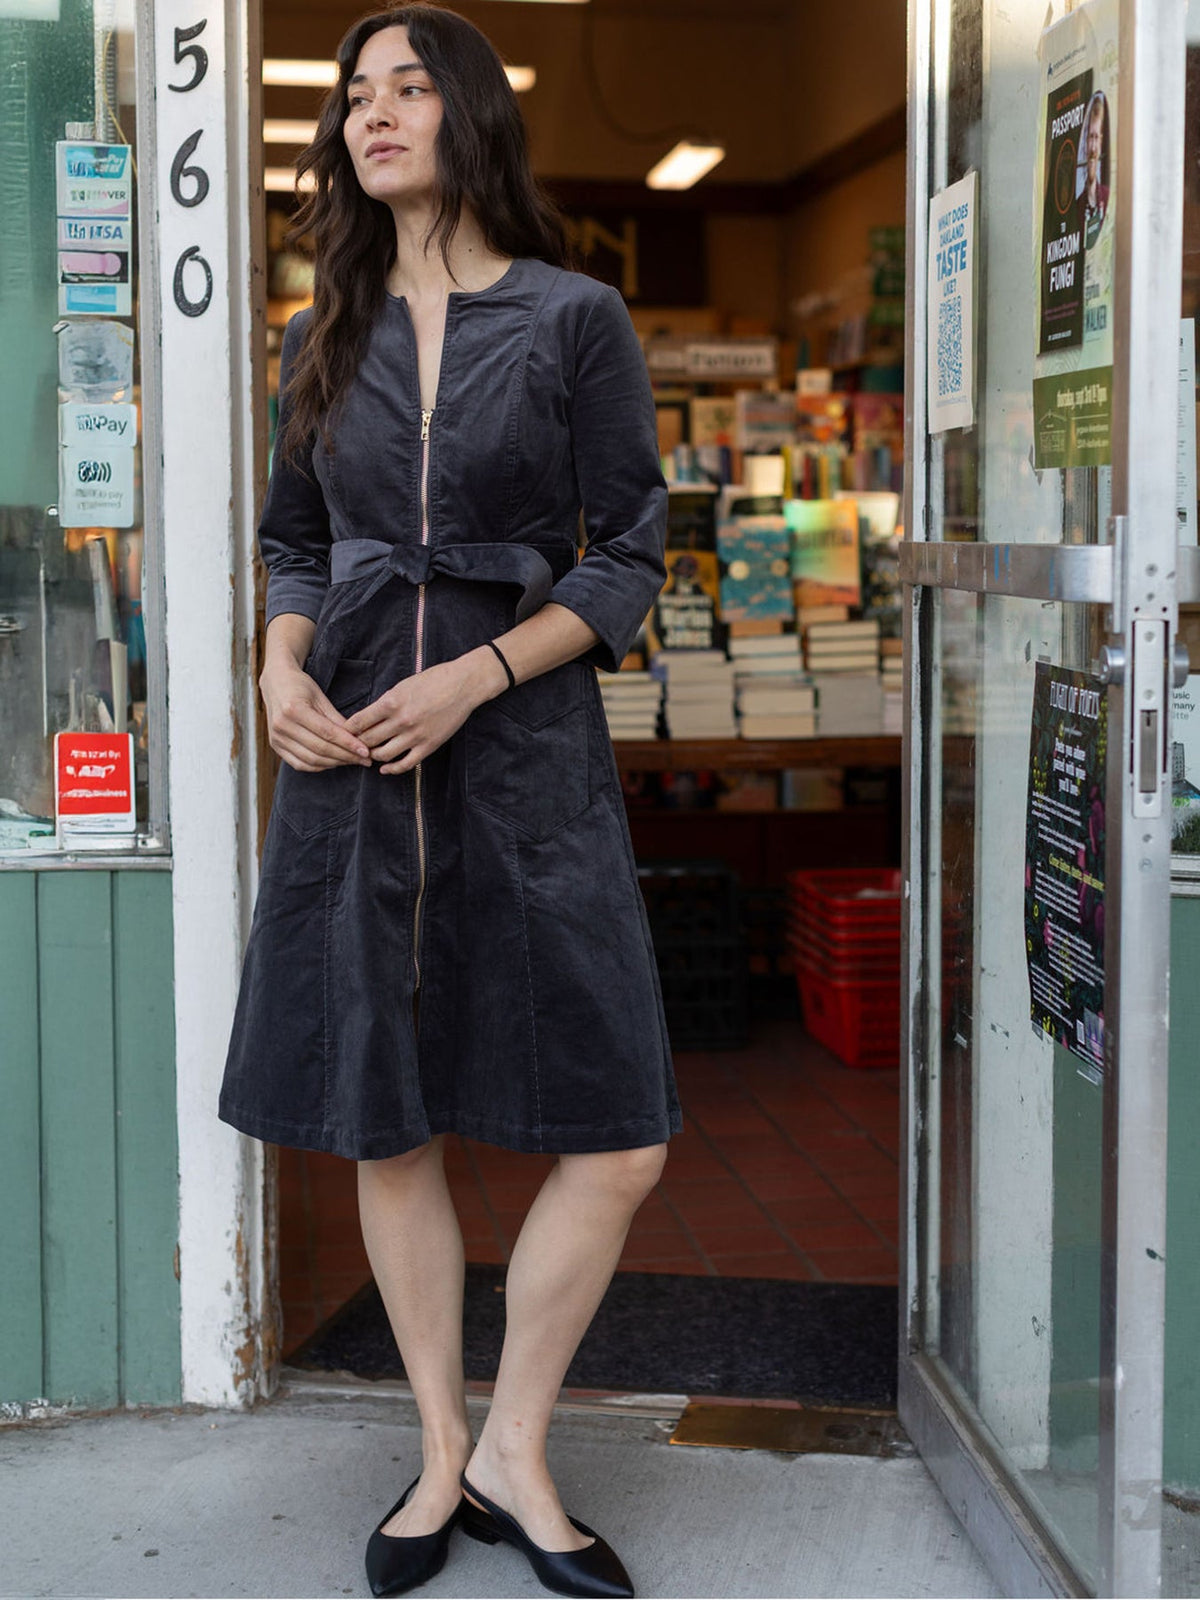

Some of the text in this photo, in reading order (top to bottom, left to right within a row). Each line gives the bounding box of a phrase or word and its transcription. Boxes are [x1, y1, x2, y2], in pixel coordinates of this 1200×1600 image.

[1052, 103, 1084, 140] PASSPORT
[938, 203, 968, 232] WHAT DOES
[940, 223, 964, 247] OAKLAND
[1047, 231, 1080, 264] KINGDOM
[936, 239, 967, 281] TASTE
[943, 278, 956, 297] LIKE?
[1050, 260, 1075, 293] FUNGI
[1172, 691, 1190, 700] usic
